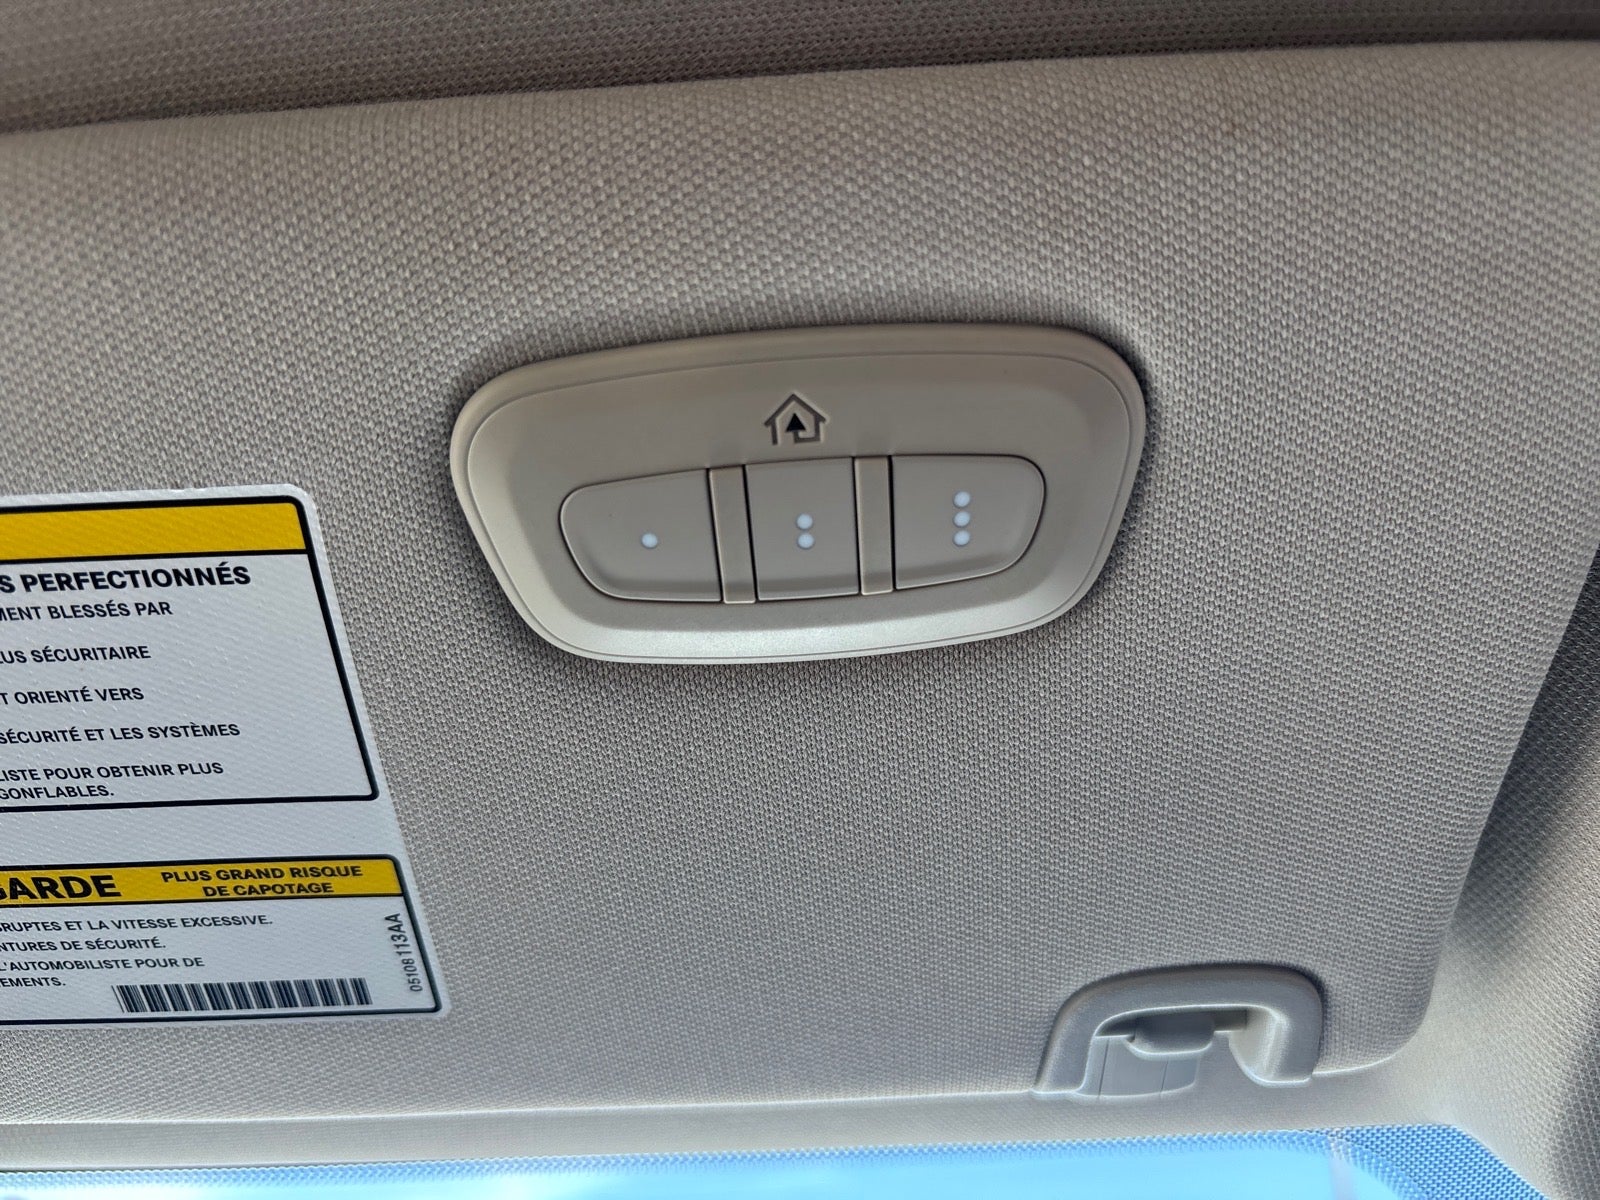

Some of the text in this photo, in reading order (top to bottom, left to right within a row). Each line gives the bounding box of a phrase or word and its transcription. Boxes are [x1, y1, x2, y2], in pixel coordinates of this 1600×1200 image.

[20, 562, 251, 592] PERFECTIONNÉS
[48, 600, 131, 620] BLESSÉS
[134, 602, 174, 616] PAR
[0, 646, 152, 664] US SÉCURITAIRE
[14, 686, 93, 705] ORIENTÉ
[94, 688, 145, 701] VERS
[0, 722, 240, 744] SÉCURITÉ ET LES SYSTÈMES
[43, 767, 94, 780] POUR
[96, 764, 175, 779] OBTENIR
[177, 762, 224, 776] PLUS
[161, 866, 363, 883] PLUS GRAND RISQUE
[202, 882, 334, 897] DE CAPOTAGE
[0, 915, 273, 932] RUPTES ET LA VITESSE EXCESSIVE.
[60, 940, 83, 950] DE
[85, 936, 166, 950] SÉCURITÉ.
[134, 958, 180, 970] POUR
[182, 957, 205, 968] DE
